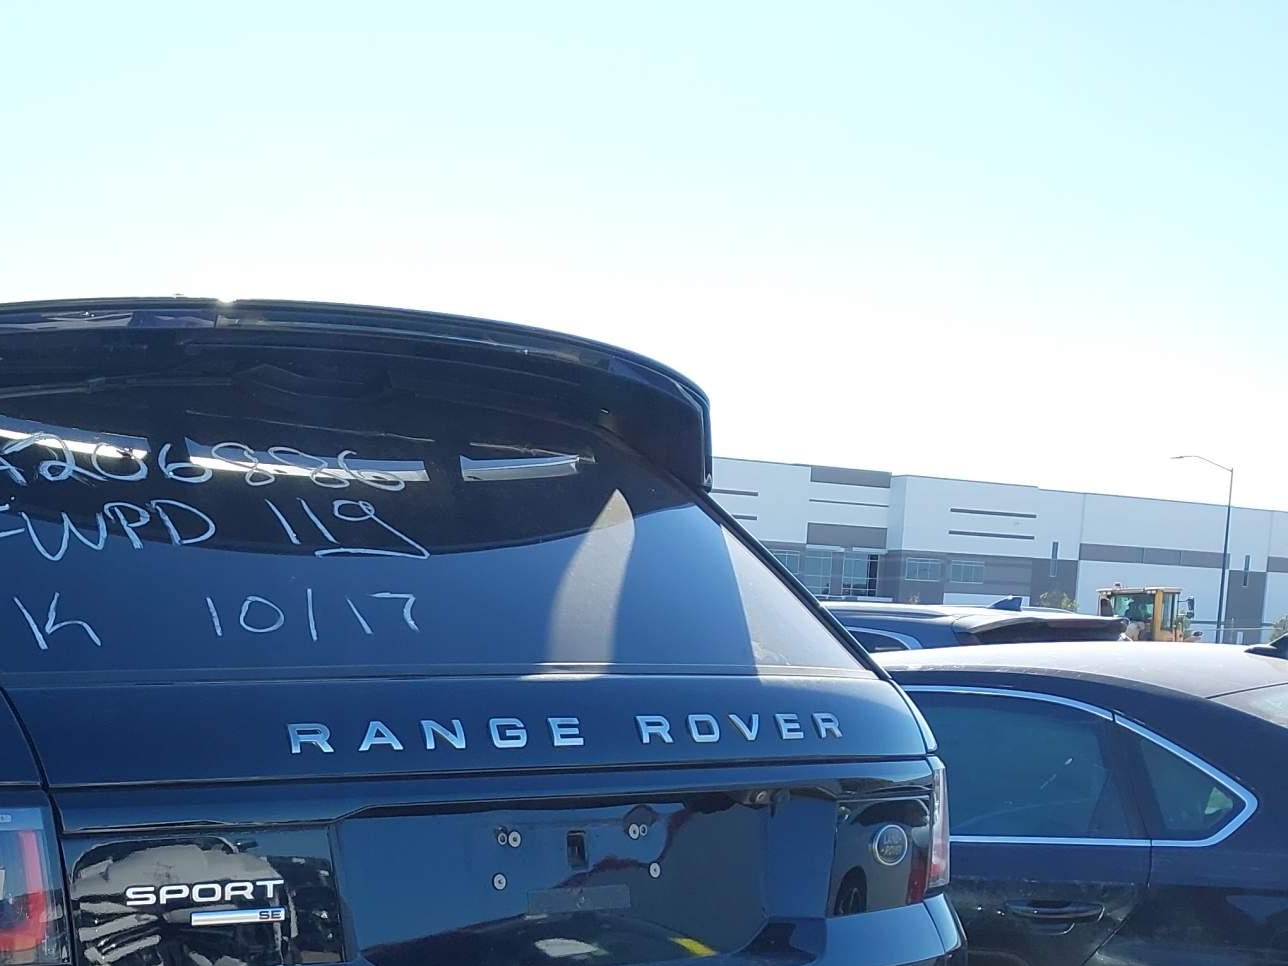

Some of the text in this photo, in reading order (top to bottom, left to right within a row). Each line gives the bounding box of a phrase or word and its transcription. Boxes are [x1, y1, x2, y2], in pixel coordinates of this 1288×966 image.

[287, 713, 844, 754] RANGE ROVER
[125, 879, 285, 906] SPORT
[259, 910, 282, 920] SE
